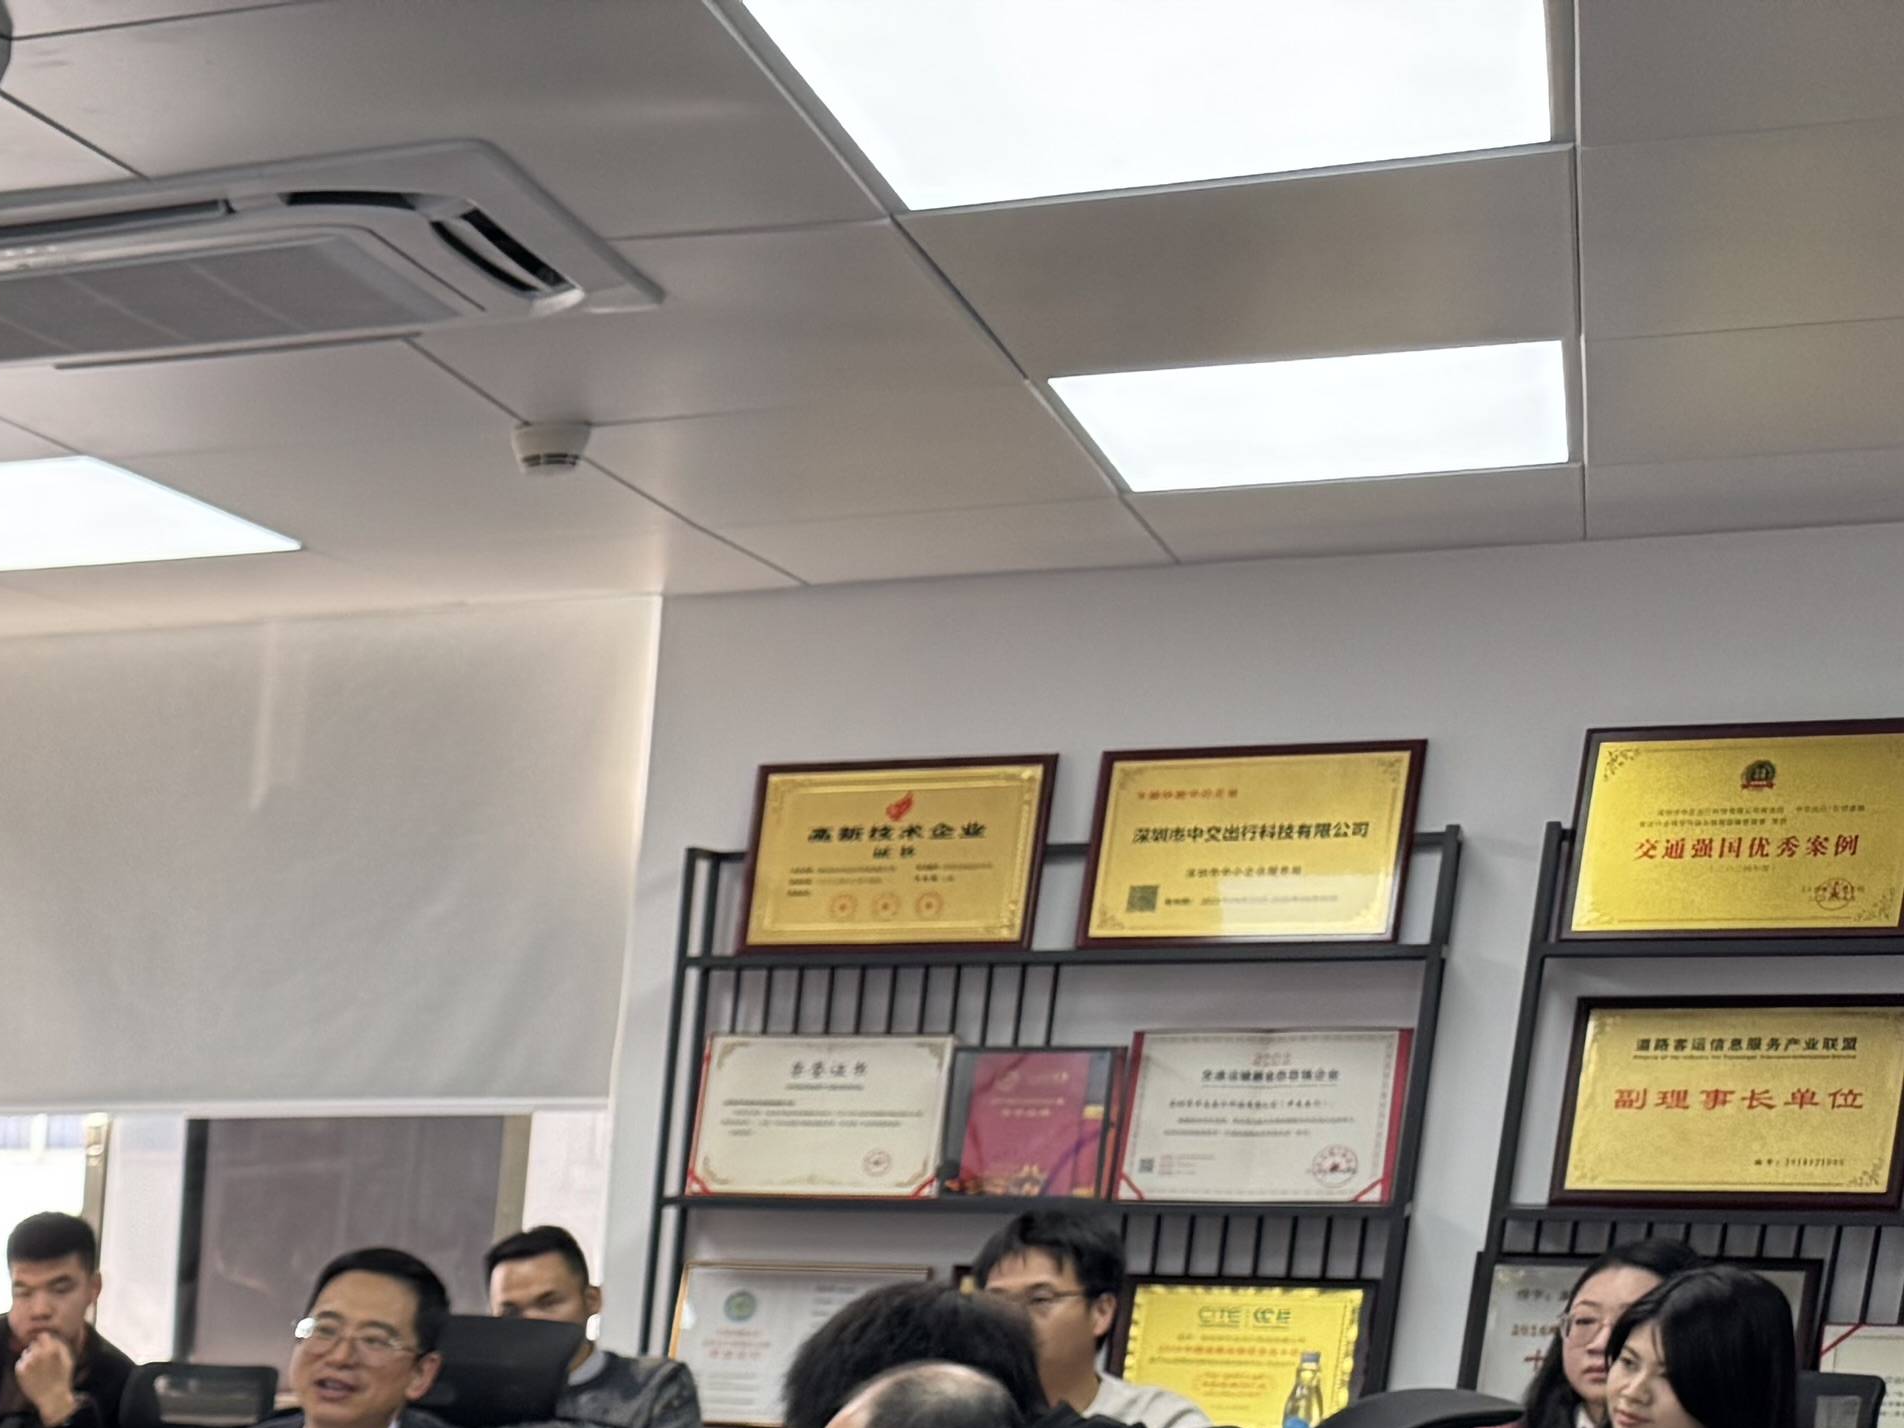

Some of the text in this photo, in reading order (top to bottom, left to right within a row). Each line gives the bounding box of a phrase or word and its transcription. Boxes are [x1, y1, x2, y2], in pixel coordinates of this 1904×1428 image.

[807, 821, 987, 843] 高新技术企业
[1132, 821, 1371, 844] 深圳市中交出行科技有限公司
[1633, 833, 1860, 861] 交通强国优秀案例
[1636, 1036, 1858, 1052] 道路客运信息服务产业联盟
[1613, 1087, 1865, 1111] 副理事长单位
